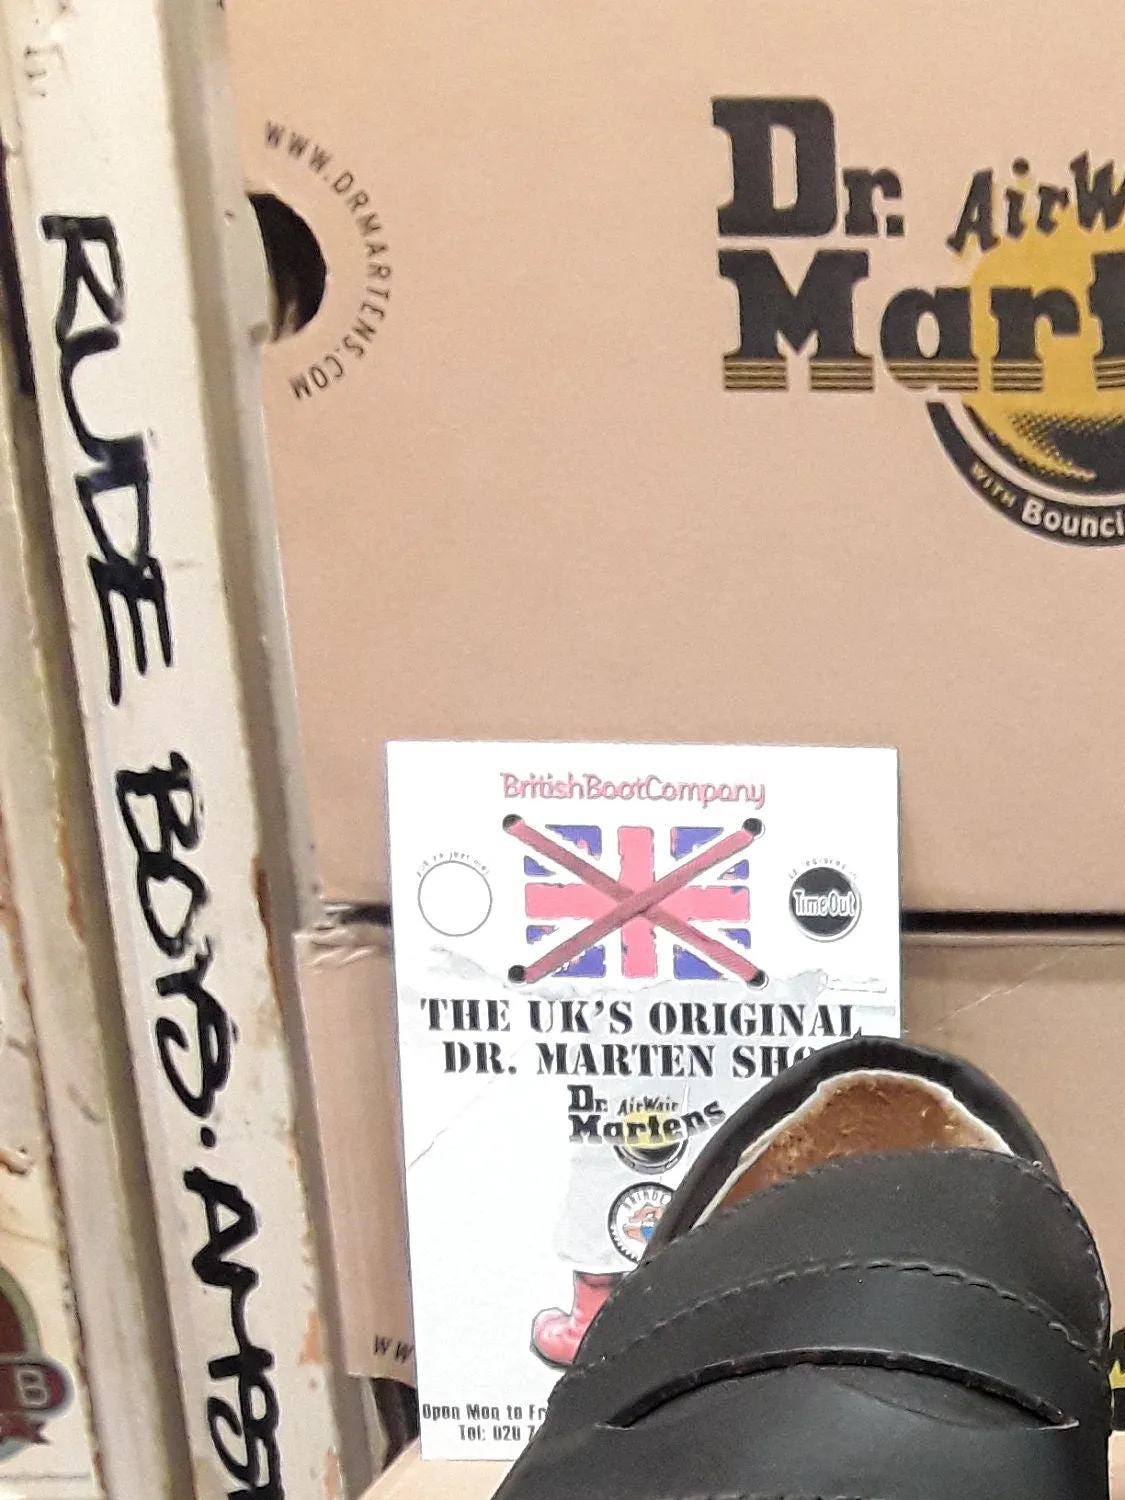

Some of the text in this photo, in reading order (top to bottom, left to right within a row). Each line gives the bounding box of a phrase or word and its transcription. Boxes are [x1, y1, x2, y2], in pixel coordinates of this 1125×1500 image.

[711, 94, 905, 239] Dr.
[264, 120, 391, 400] WWW.DRMARTENS.COM
[40, 214, 175, 707] RUDE
[970, 462, 1017, 508] WITH
[500, 770, 766, 810] BritishBootCompany
[420, 997, 863, 1040] THE UK'S ORIGINAL
[443, 1041, 517, 1076] DR.
[536, 1042, 716, 1079] MARTEN
[567, 1084, 609, 1113] Dr.
[568, 1100, 727, 1144] Martens
[466, 1404, 501, 1421] Mon
[507, 1404, 523, 1421] to
[529, 1404, 547, 1421] Fr
